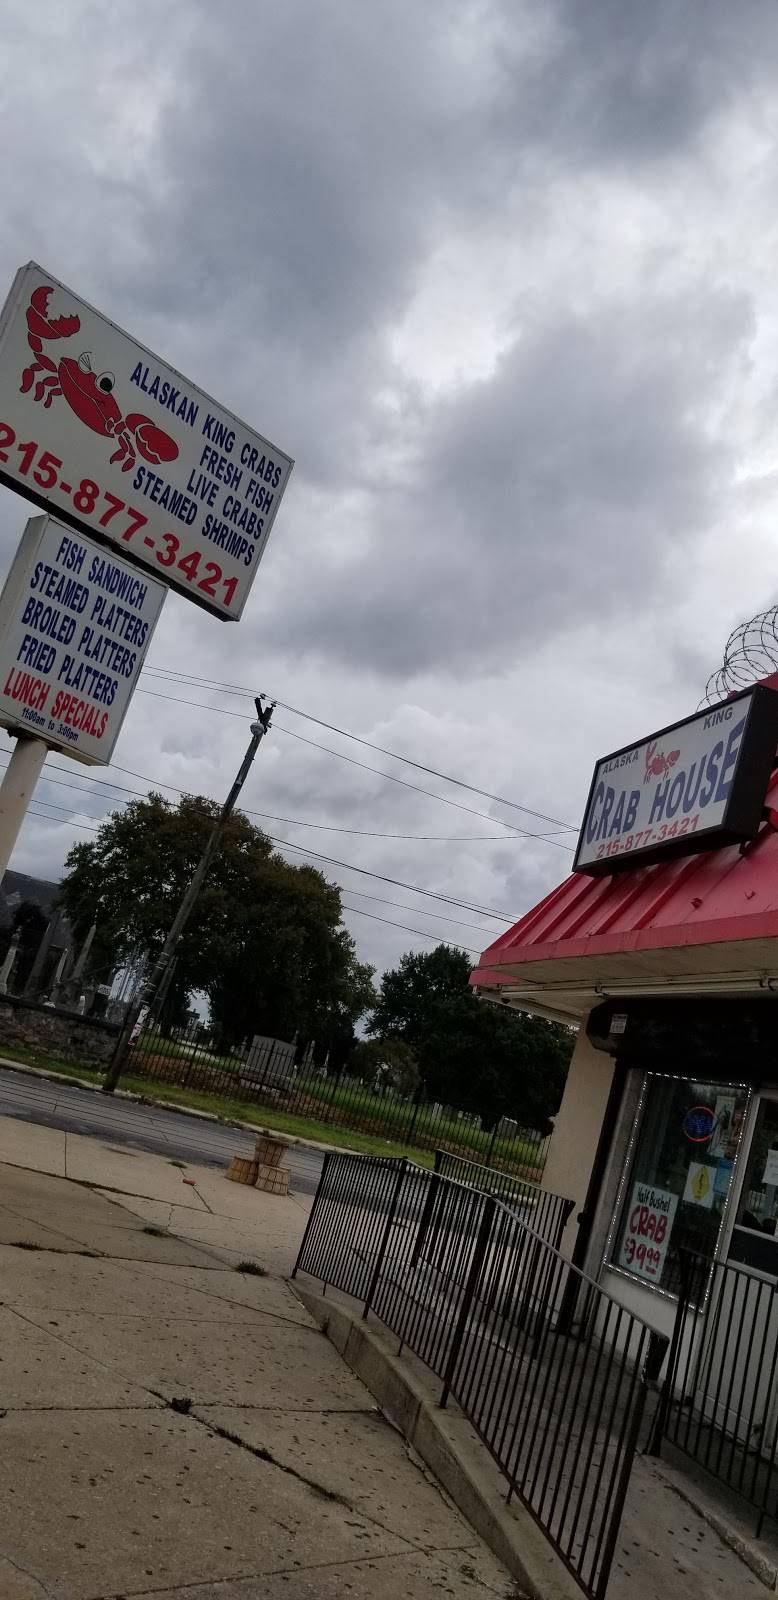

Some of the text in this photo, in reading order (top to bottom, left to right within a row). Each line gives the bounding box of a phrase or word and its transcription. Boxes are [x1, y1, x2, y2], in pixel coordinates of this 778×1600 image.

[130, 362, 282, 489] ALASKAN KING CRABS
[0, 422, 240, 607] 215-877-3421
[132, 466, 256, 567] STEAMED SHRIMPS
[186, 469, 265, 540] LIVE CRABS
[200, 448, 274, 515] FRESH FISH
[30, 561, 149, 648] STEAMED PLATTERS
[55, 536, 148, 610] FISH SANDWICH
[16, 634, 119, 706] FRIED PLATTERS
[21, 597, 137, 679] BROILED PLATTERS
[3, 667, 109, 739] LUNCH SPECIALS
[22, 707, 79, 741] 11:00am to 3:00pm
[602, 706, 733, 775] ALASKA KING
[586, 715, 747, 845] CRAB HOUSE
[596, 814, 700, 859] 215-877-3421
[629, 1204, 668, 1244] CRAB
